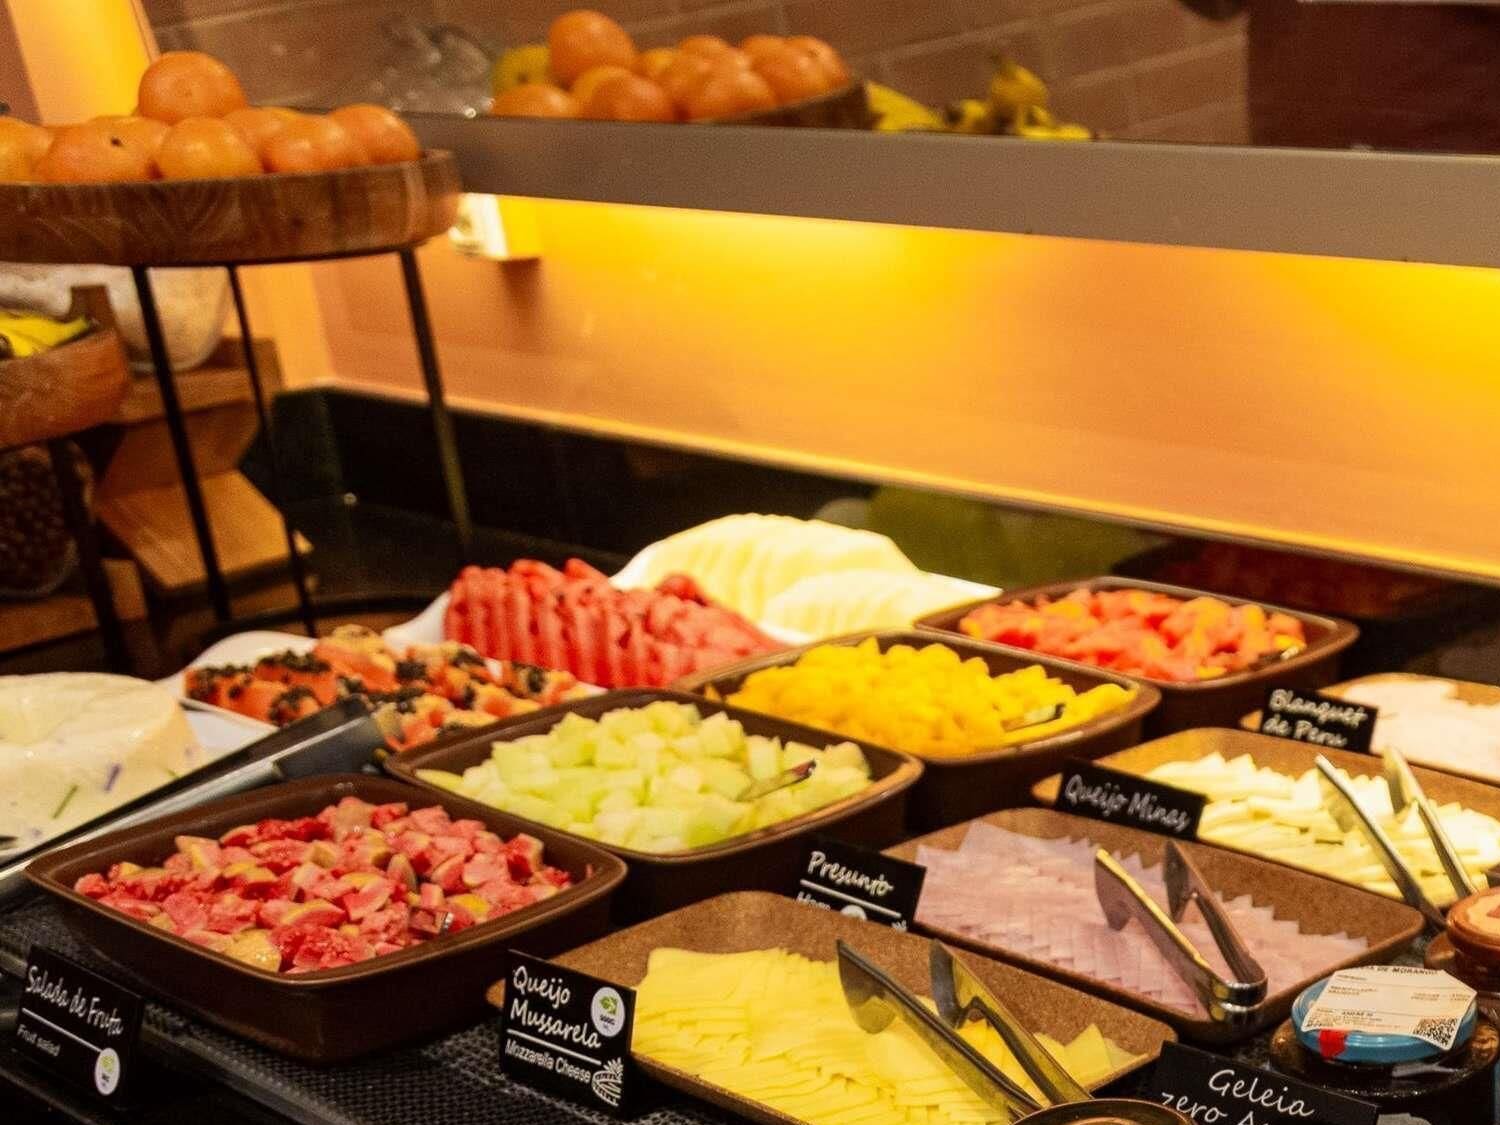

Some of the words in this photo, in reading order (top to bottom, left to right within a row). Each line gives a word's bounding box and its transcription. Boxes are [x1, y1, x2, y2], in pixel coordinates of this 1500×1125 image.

[1064, 774, 1124, 816] Queijo
[1125, 792, 1191, 832] Minas
[807, 850, 895, 897] Presunto
[25, 964, 69, 1007] Salada
[69, 987, 87, 1018] de
[87, 997, 124, 1036] Fruta
[513, 965, 571, 1009] Queijo
[510, 998, 602, 1048] Mussarela
[555, 1057, 592, 1083] Cheese
[1207, 1069, 1314, 1118] Geleia
